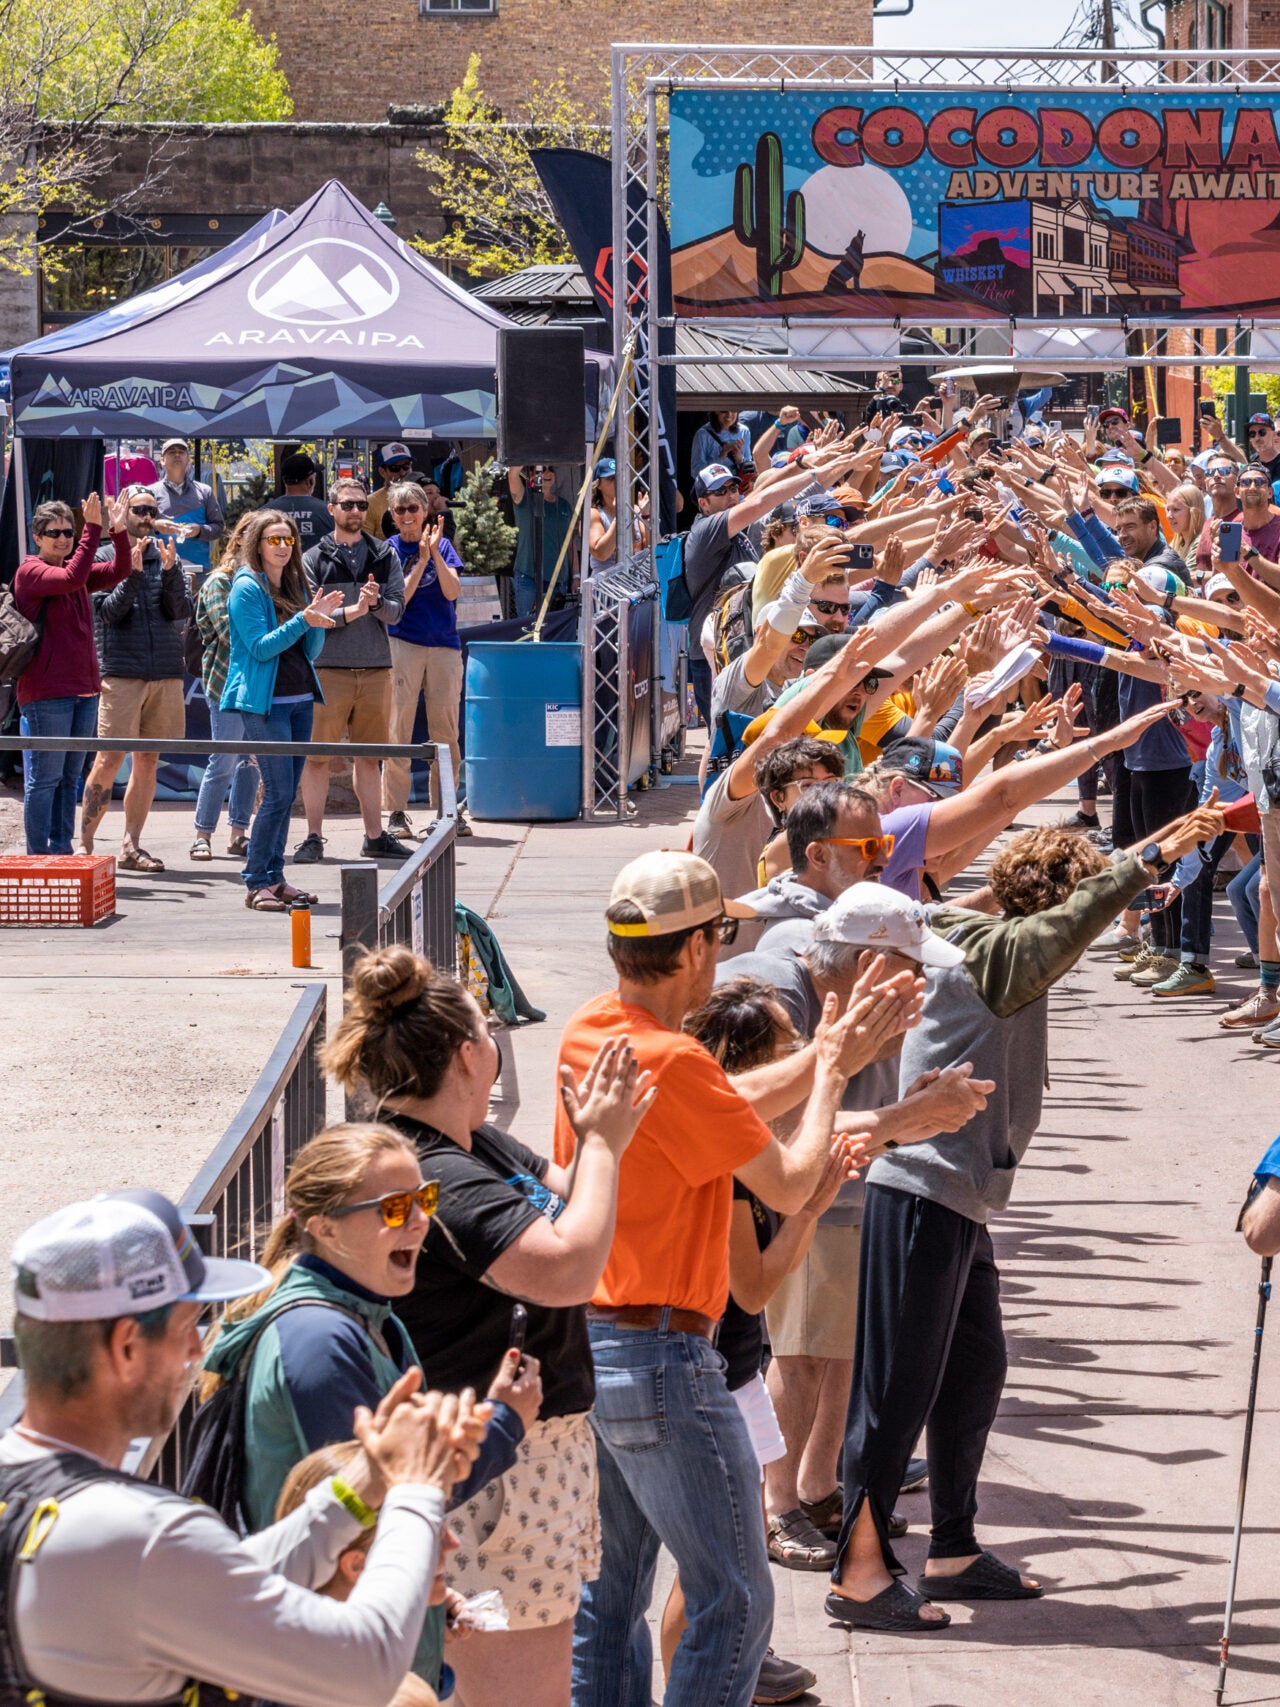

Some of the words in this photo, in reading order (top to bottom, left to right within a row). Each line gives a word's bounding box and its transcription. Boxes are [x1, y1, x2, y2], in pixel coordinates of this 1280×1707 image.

[945, 170, 1160, 199] ADVENTURE
[942, 264, 1005, 284] WHISKEY
[204, 328, 425, 349] ARAVAIPA
[70, 387, 194, 407] ARAVAIPA
